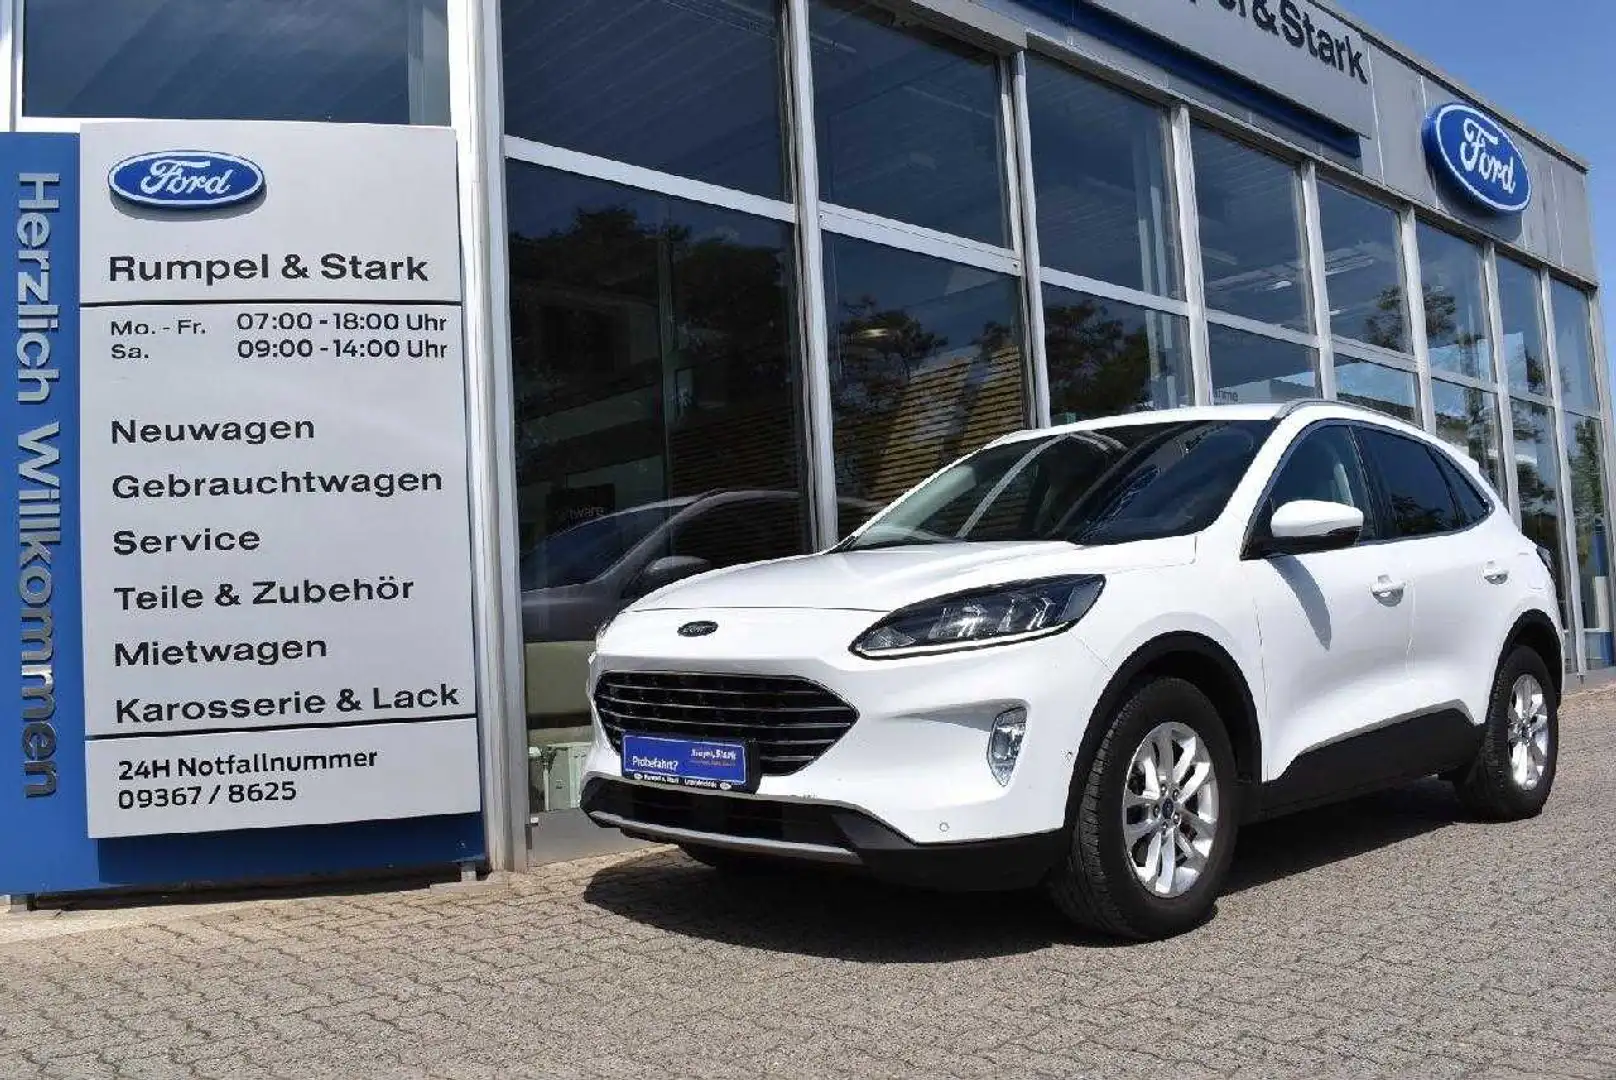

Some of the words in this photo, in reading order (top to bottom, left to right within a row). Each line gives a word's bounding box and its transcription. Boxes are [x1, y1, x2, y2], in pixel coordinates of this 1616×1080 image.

[1460, 118, 1517, 195] Ford
[139, 158, 232, 196] Ford
[109, 254, 269, 286] Rumpel
[281, 254, 310, 280] &
[320, 253, 430, 281] Stark
[16, 172, 61, 403] Herzlich
[110, 320, 156, 336] Mo.
[177, 319, 206, 335] Fr.
[237, 312, 313, 330] 07:00
[406, 313, 447, 331] Uhr
[111, 343, 149, 360] Sa.
[237, 339, 313, 358] 09:00
[407, 339, 448, 359] Uhr
[111, 417, 315, 445] Neuwagen
[112, 471, 442, 500] Gebrauchtwagen
[113, 527, 261, 556] Service
[17, 420, 62, 798] Willkommen
[114, 584, 204, 611] Teile
[214, 583, 242, 607] &
[252, 577, 415, 605] Zubehör
[114, 636, 327, 667] Mietwagen
[116, 690, 327, 723] Karosserie
[336, 688, 361, 712] &
[372, 683, 460, 710] Lack
[118, 757, 171, 781] 24H
[177, 749, 378, 778] Notfallnummer
[118, 785, 202, 810] 09367
[207, 784, 221, 806] /
[228, 781, 297, 804] 8625
